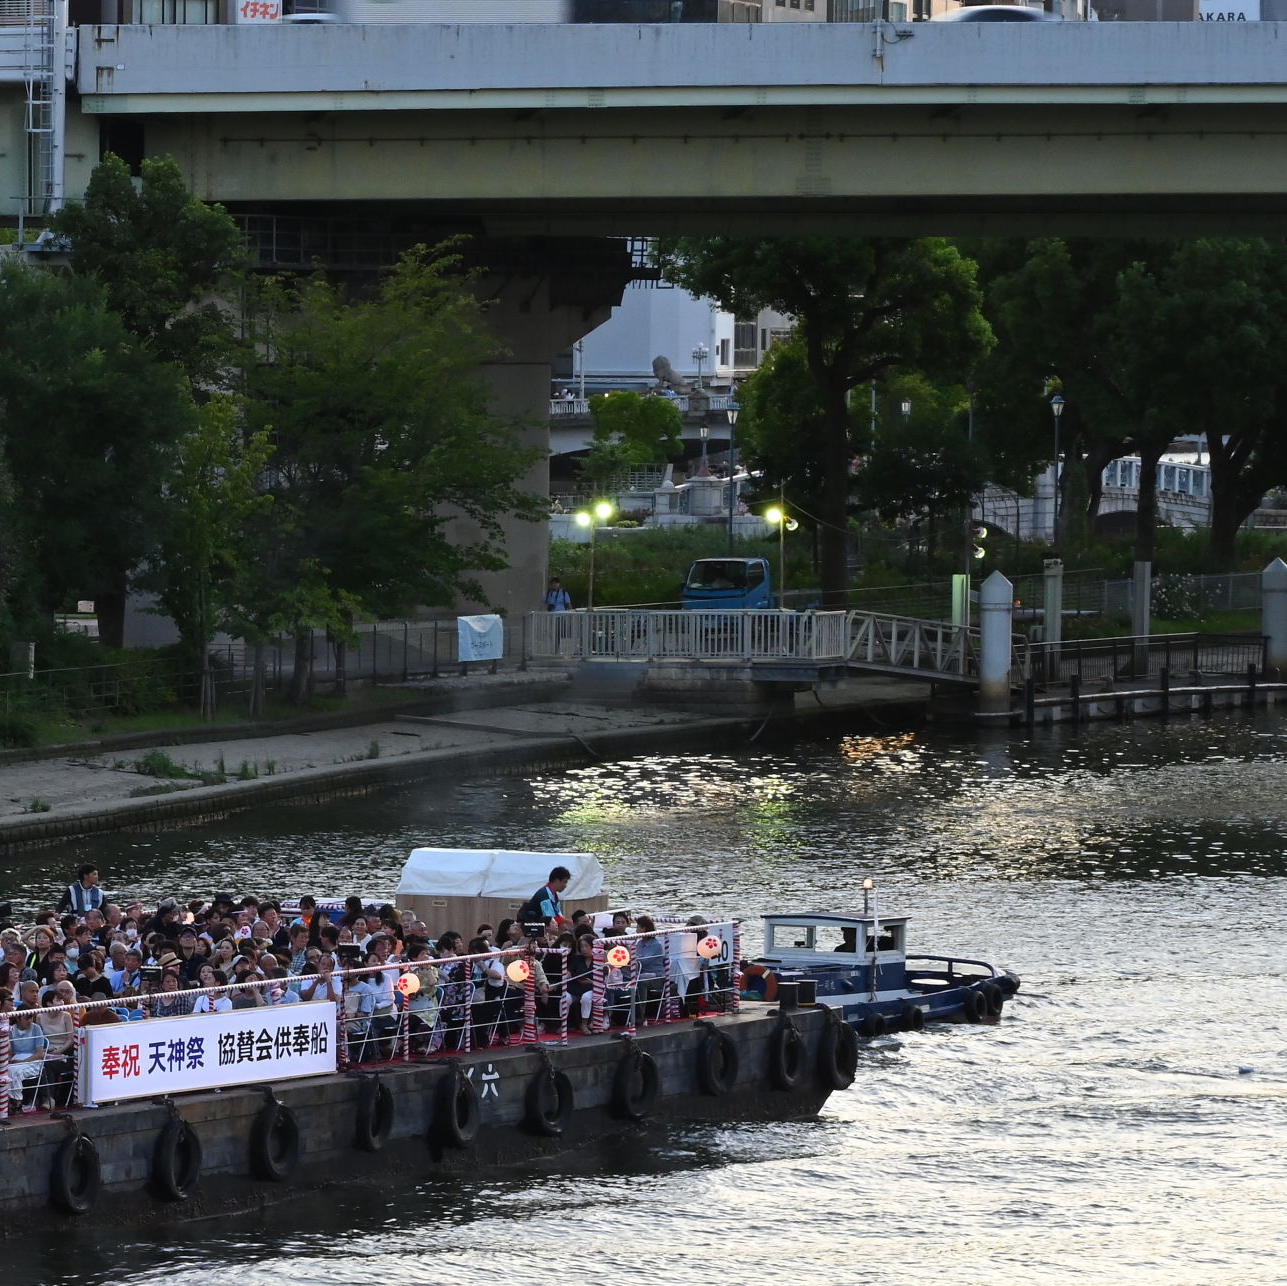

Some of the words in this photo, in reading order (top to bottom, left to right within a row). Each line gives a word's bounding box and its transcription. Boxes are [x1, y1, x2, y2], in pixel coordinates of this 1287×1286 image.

[240, 1, 278, 19] イチネン
[102, 1044, 140, 1080] 奉祝
[148, 1036, 205, 1075] 天神祭
[218, 1021, 329, 1066] 協賛会供奉船
